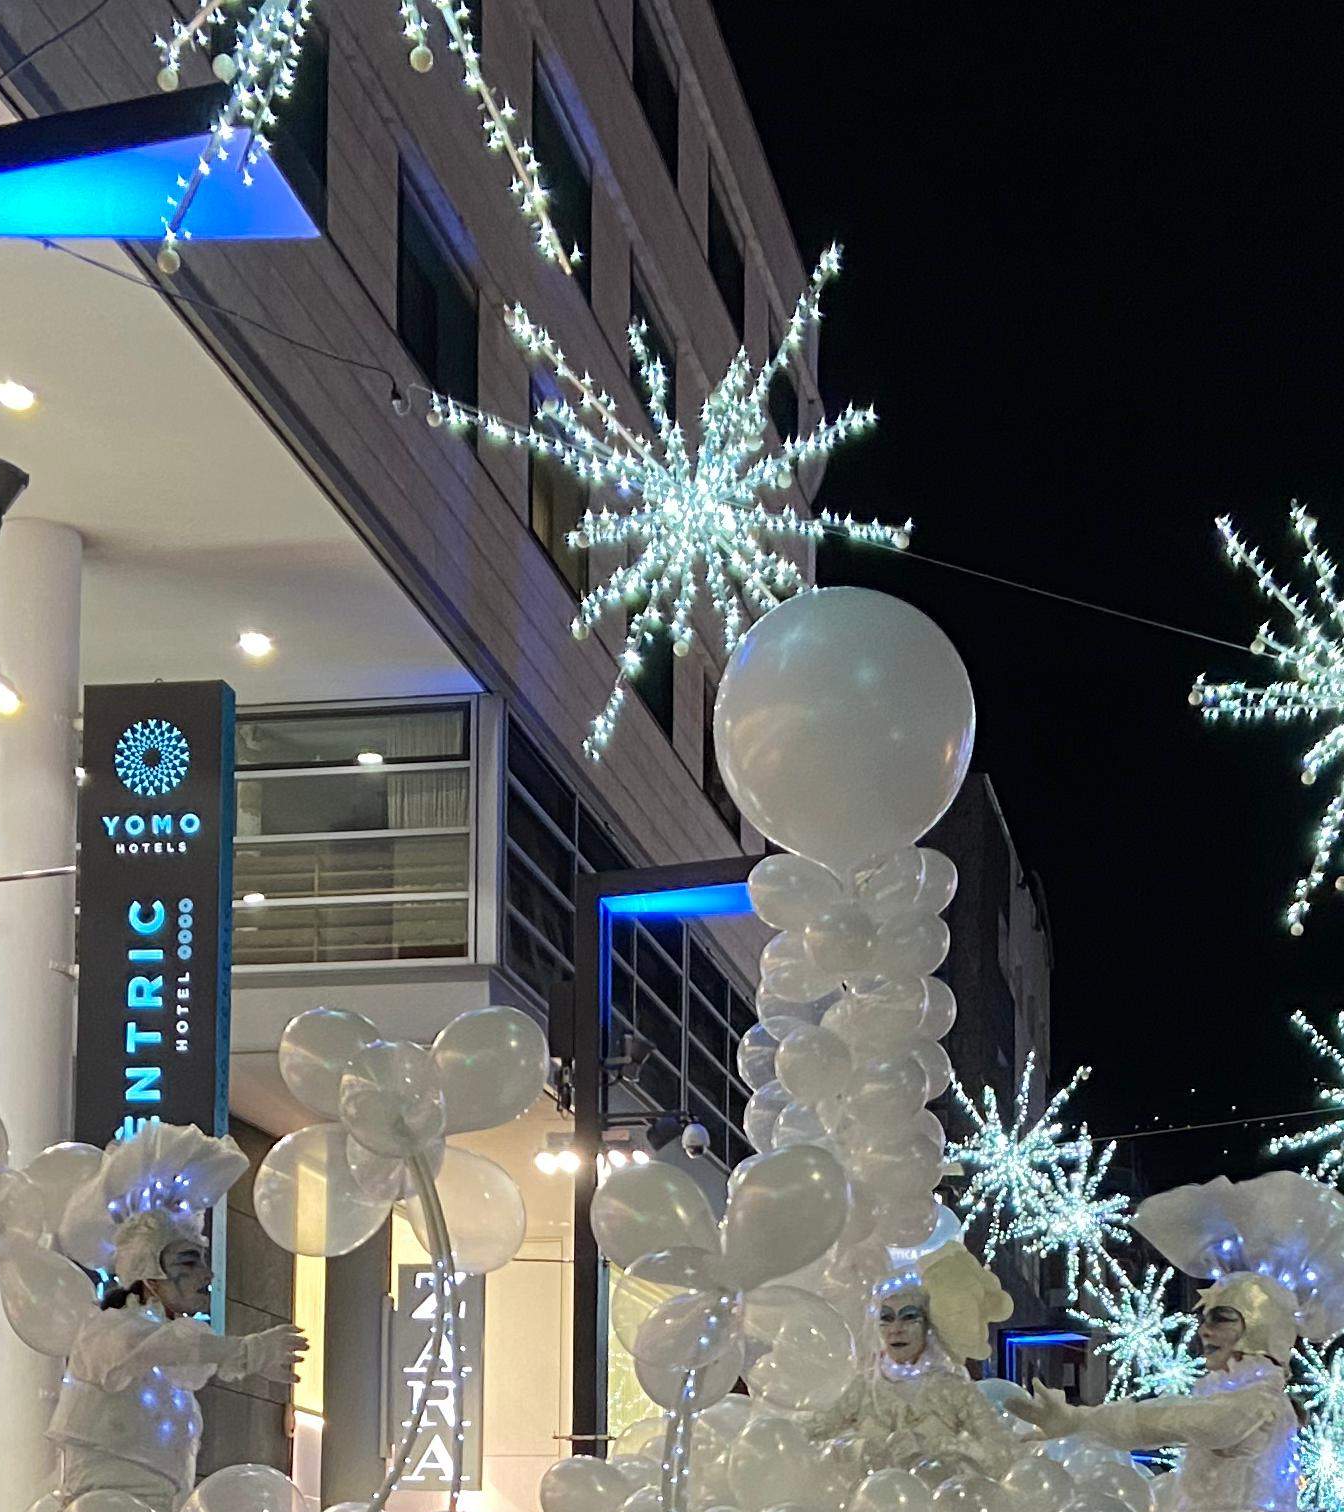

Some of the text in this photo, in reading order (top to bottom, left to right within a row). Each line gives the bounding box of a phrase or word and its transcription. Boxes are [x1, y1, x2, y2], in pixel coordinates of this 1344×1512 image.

[102, 812, 201, 837] YOMO
[115, 841, 188, 854] HOTELS
[114, 900, 166, 1145] ÈNTRIC
[176, 970, 190, 1052] HOTEL
[401, 1271, 473, 1482] ZARA
